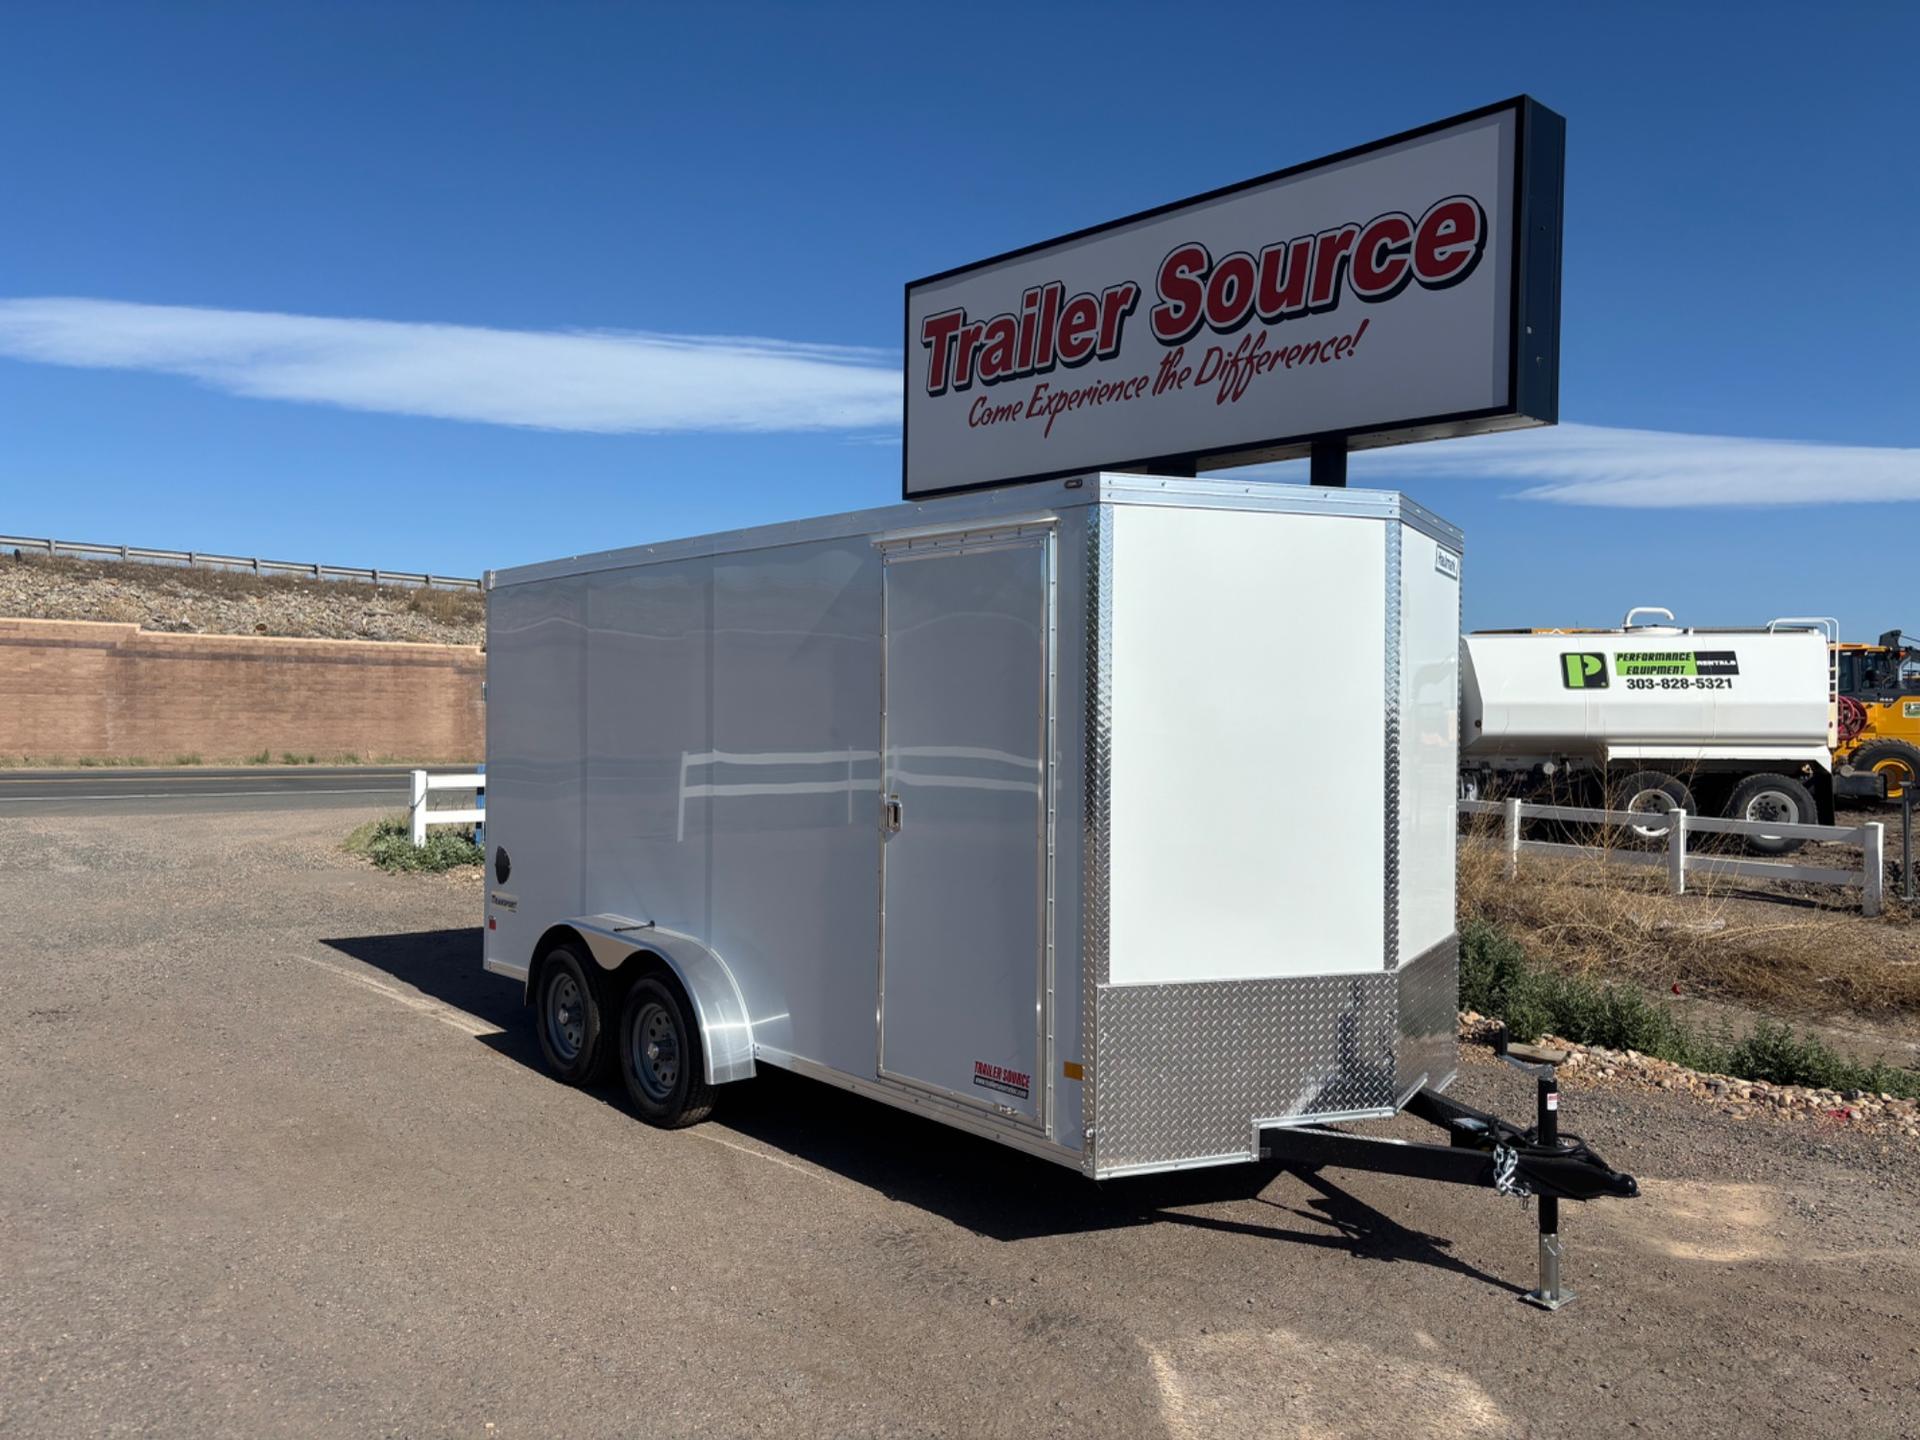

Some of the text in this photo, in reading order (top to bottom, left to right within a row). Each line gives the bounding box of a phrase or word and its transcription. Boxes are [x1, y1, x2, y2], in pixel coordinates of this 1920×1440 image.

[921, 195, 1488, 398] Trailer Source
[968, 318, 1370, 439] Come Experience the Difference!
[1616, 651, 1692, 662] PERFORMANCE
[1626, 665, 1686, 675] EQUIPMENT
[1626, 678, 1733, 690] 303-828-5321
[975, 1061, 1002, 1080] TRAILER
[1003, 1069, 1030, 1088] SOURCE
